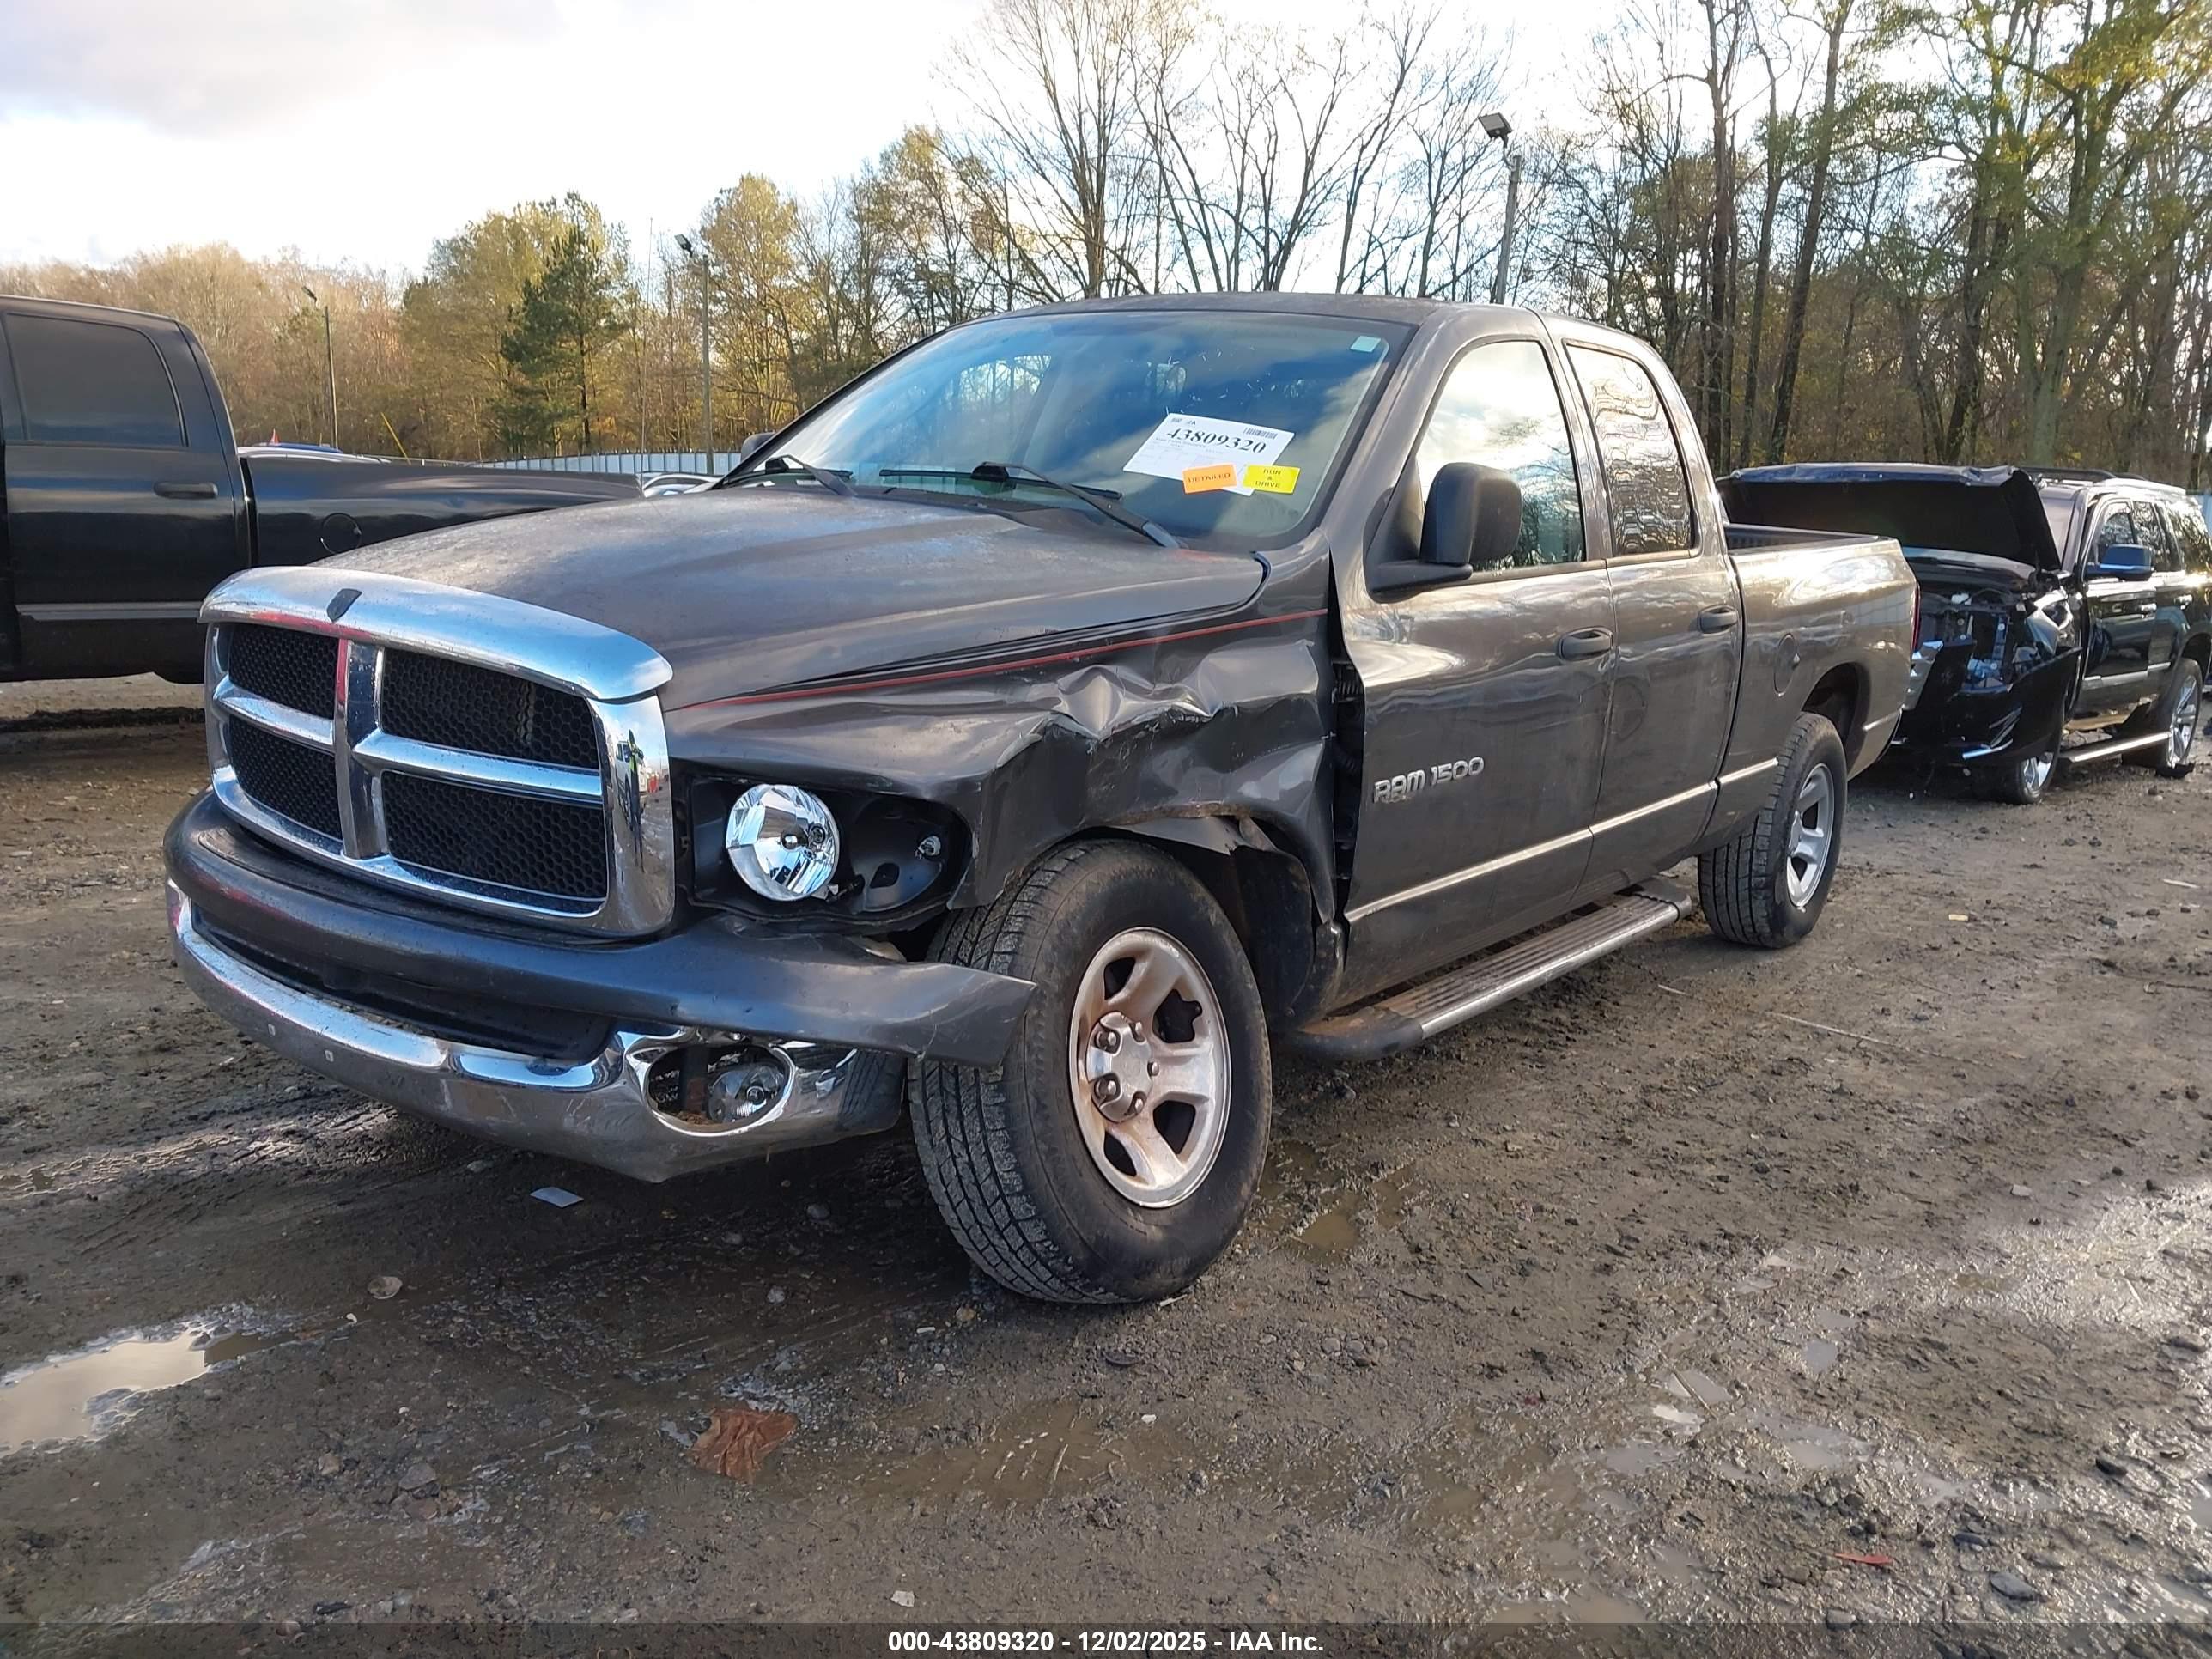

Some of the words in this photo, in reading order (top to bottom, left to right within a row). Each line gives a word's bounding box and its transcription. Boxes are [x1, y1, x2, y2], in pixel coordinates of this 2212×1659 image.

[1167, 428, 1267, 453] 43809320
[1188, 472, 1231, 483] DETAILED
[1374, 769, 1425, 803] RAM
[1431, 756, 1485, 787] 1500
